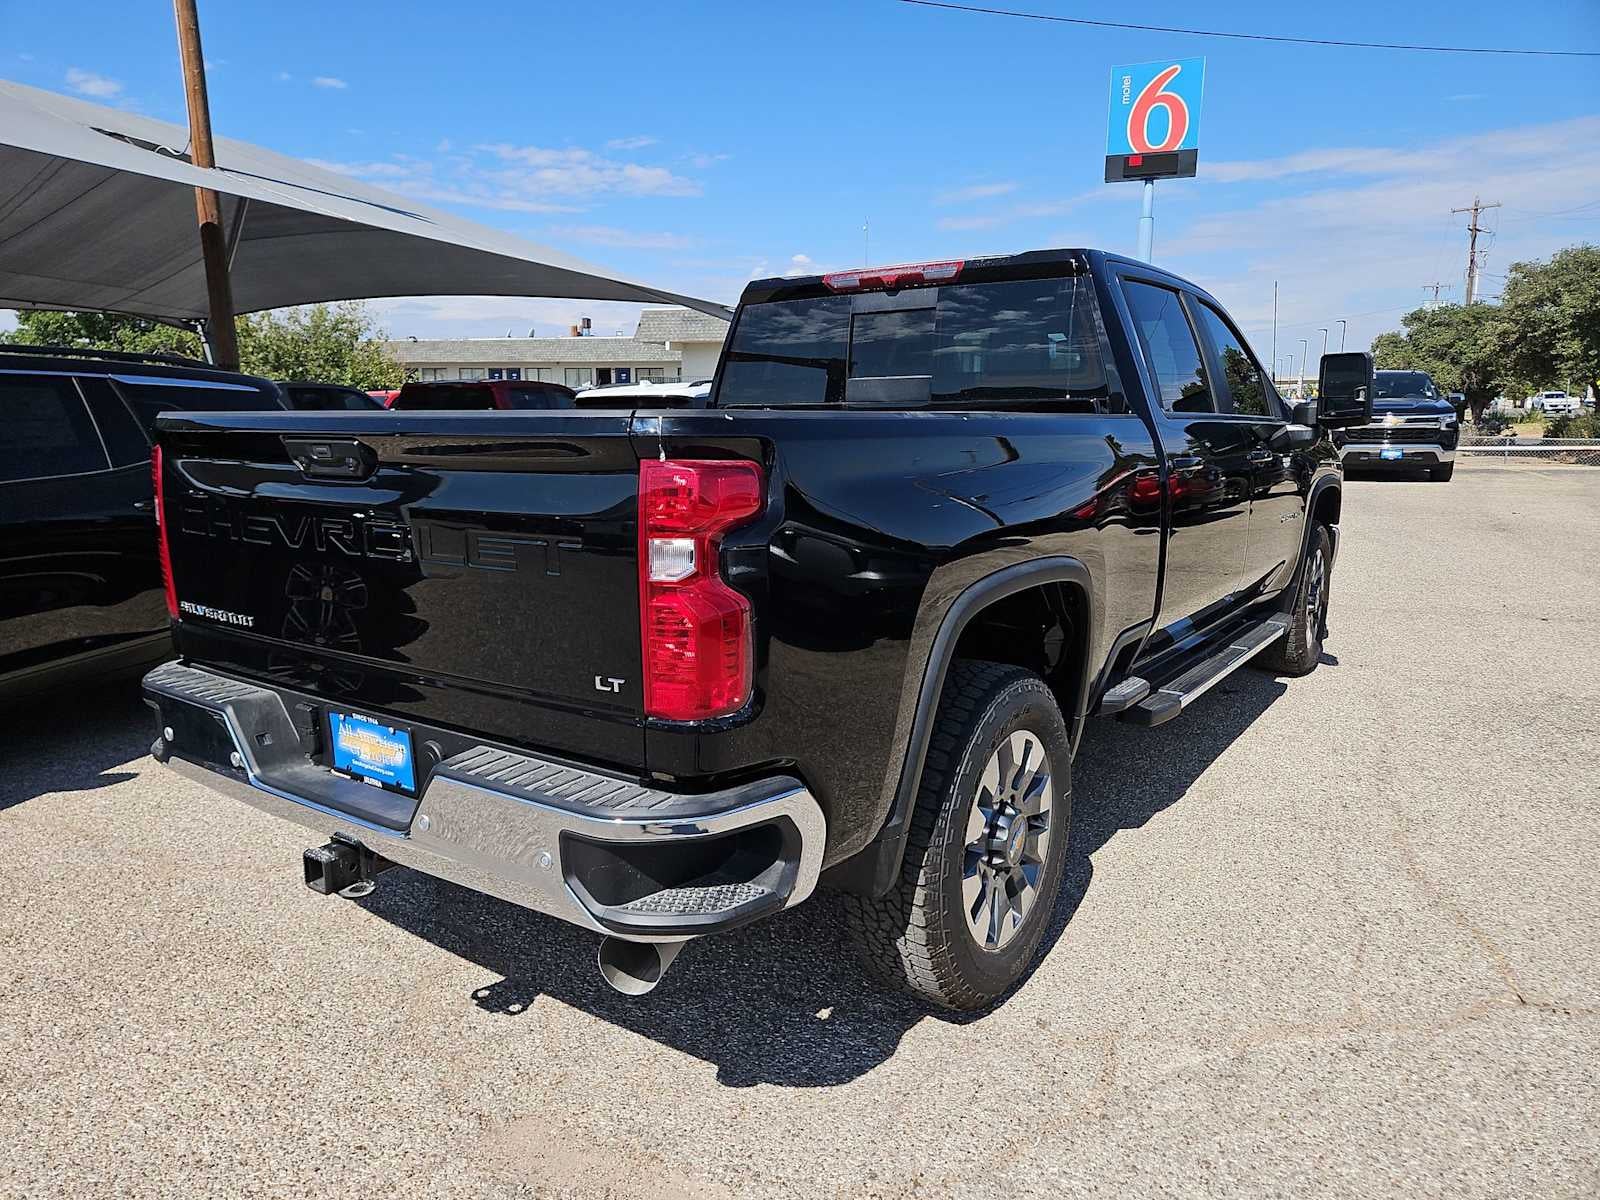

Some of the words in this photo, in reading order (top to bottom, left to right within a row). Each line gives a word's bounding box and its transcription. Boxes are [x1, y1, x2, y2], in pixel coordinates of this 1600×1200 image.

[1121, 75, 1132, 105] motel
[1127, 64, 1189, 153] 6
[181, 502, 584, 577] CHEVROLET
[595, 675, 626, 693] LT
